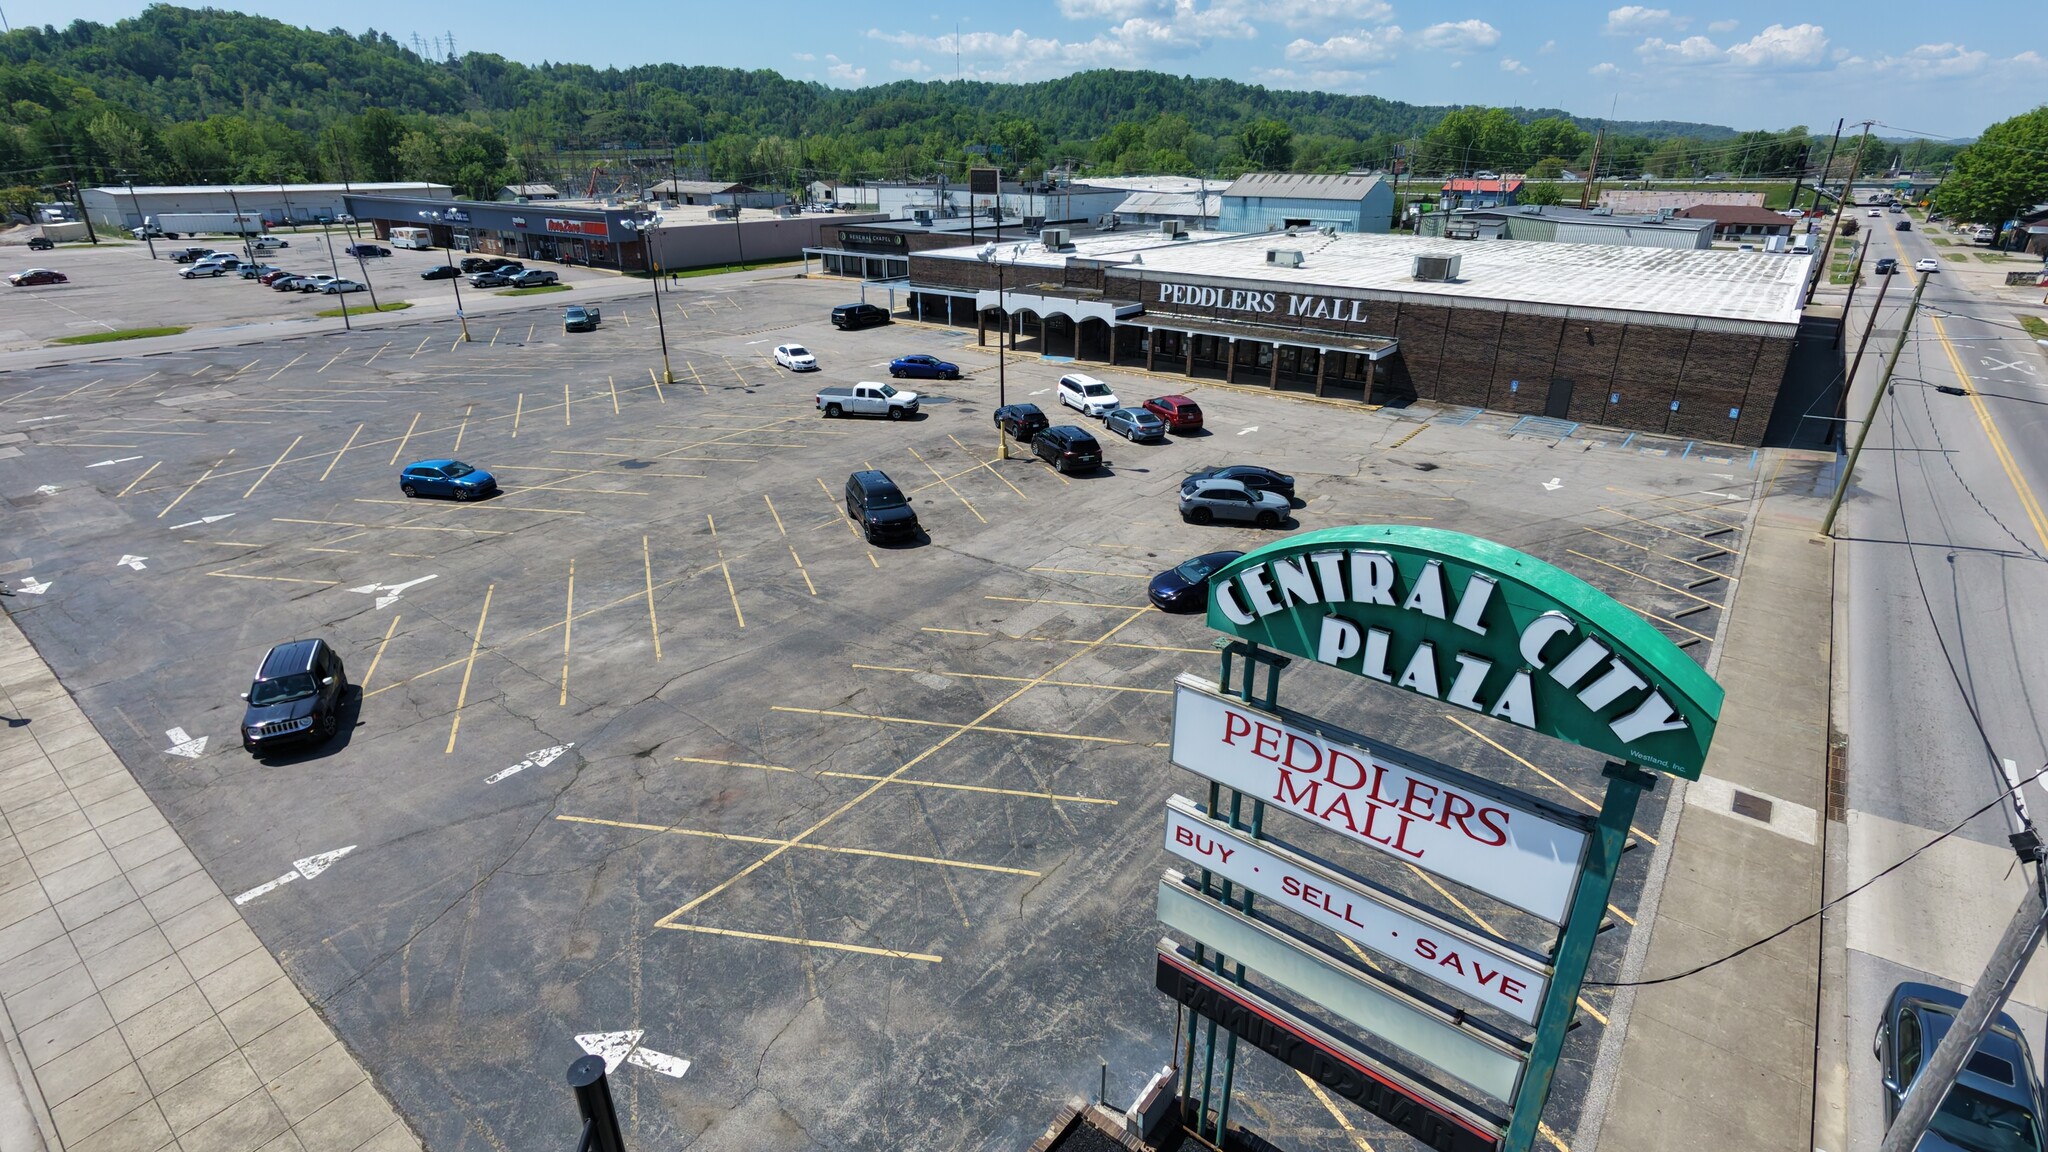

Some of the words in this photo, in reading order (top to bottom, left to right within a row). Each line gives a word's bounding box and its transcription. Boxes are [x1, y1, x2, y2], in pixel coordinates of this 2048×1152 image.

[1159, 283, 1276, 313] PEDDLERS
[1288, 294, 1368, 323] MALL
[1215, 548, 1499, 636] CENTRAL
[1518, 610, 1690, 744] CITY
[1317, 612, 1537, 729] PLAZA
[1221, 710, 1510, 847] PEDDLERS
[1273, 767, 1425, 858] MALL
[1630, 749, 1669, 768] Westland,
[1672, 763, 1686, 772] Inc.
[1175, 825, 1235, 864] BUY
[1281, 875, 1365, 929] SELL
[1414, 938, 1528, 1004] SAVE
[1178, 972, 1303, 1064] FAMILY
[1311, 1049, 1455, 1152] DOLLAR
